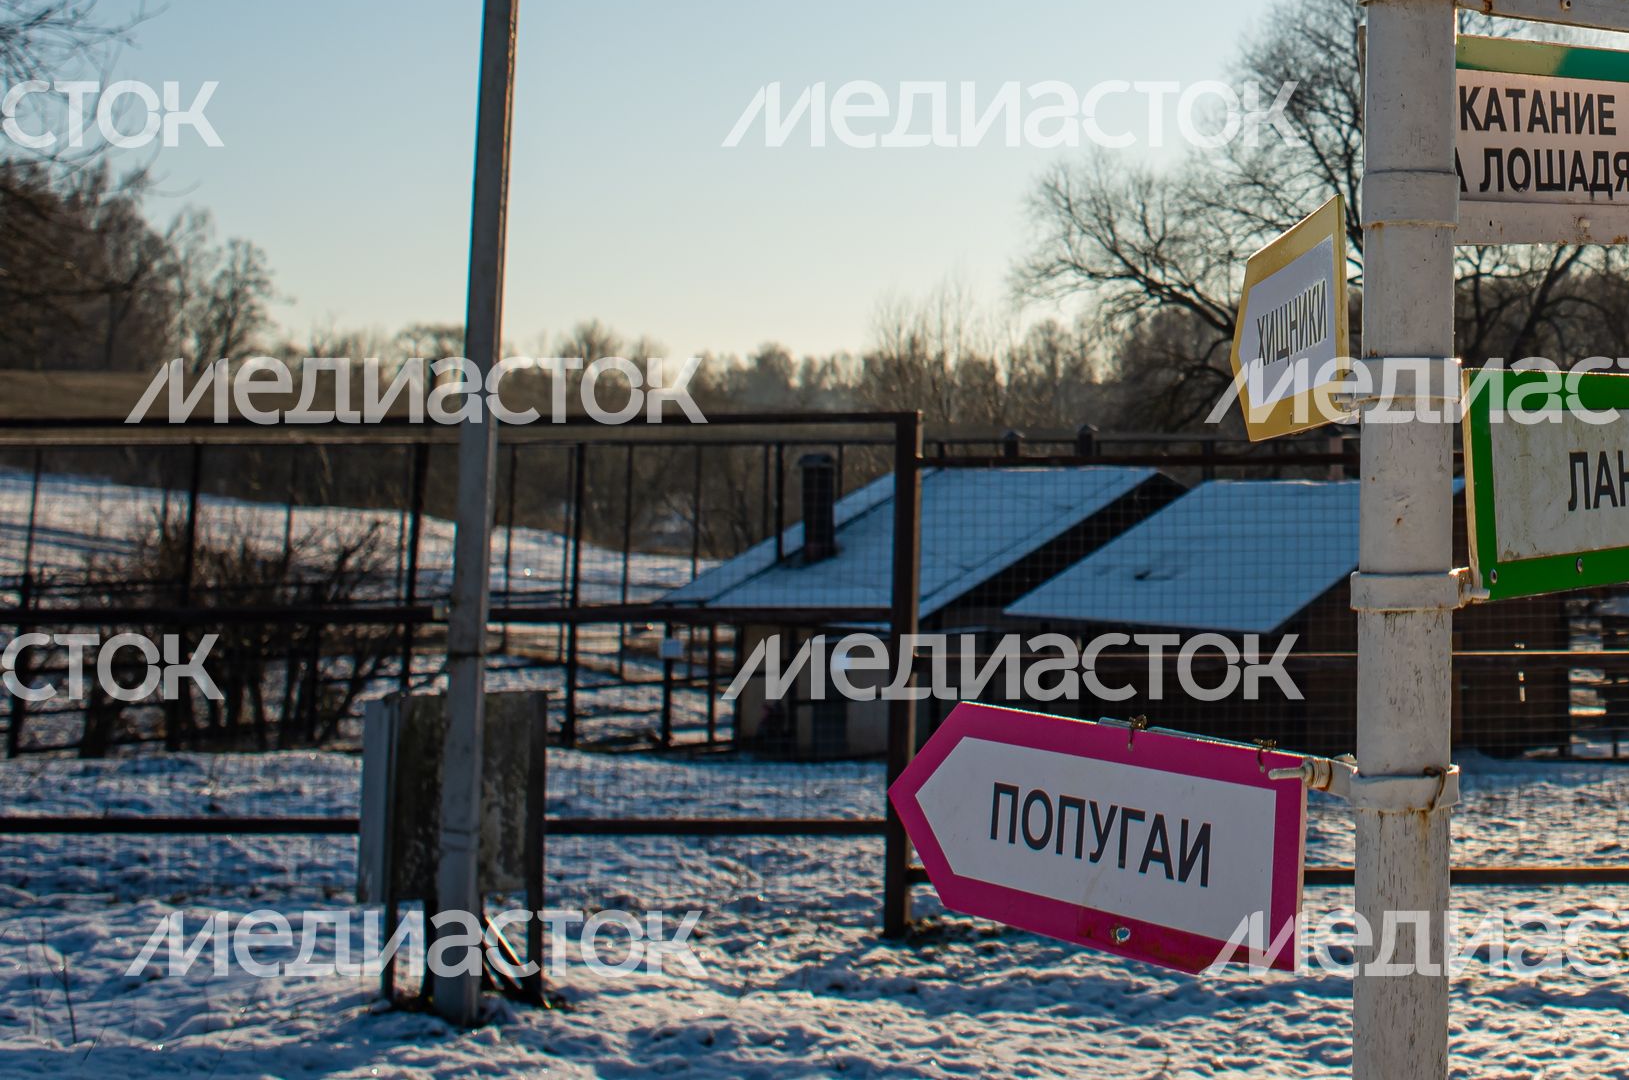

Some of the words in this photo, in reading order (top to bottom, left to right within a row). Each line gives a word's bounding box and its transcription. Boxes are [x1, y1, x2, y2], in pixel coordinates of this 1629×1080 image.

[1458, 85, 1617, 136] КАТАНИЕ
[1256, 279, 1328, 368] ХИЩНИКИ
[989, 782, 1212, 889] ПОПУГАИ
